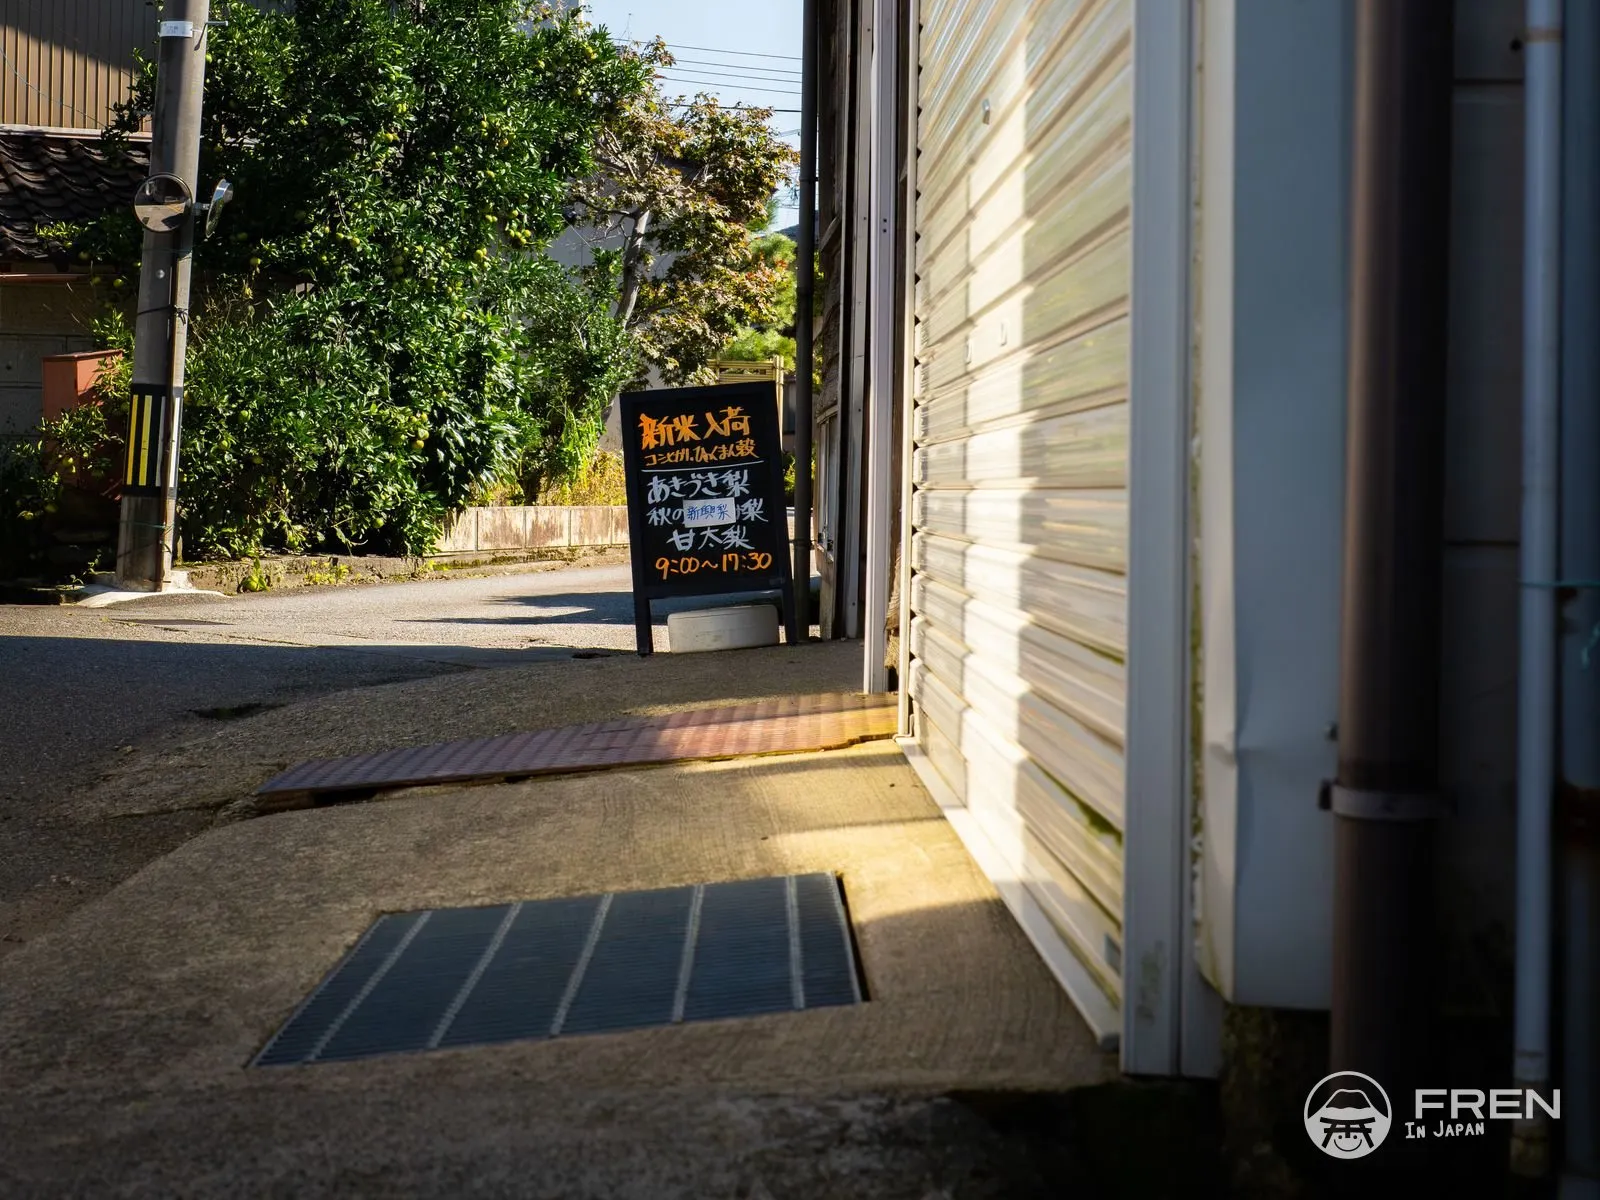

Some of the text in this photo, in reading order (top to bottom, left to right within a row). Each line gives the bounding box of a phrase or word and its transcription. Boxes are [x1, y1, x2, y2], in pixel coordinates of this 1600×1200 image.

[647, 469, 750, 504] あきづき梨
[666, 525, 755, 551] 甘太梨
